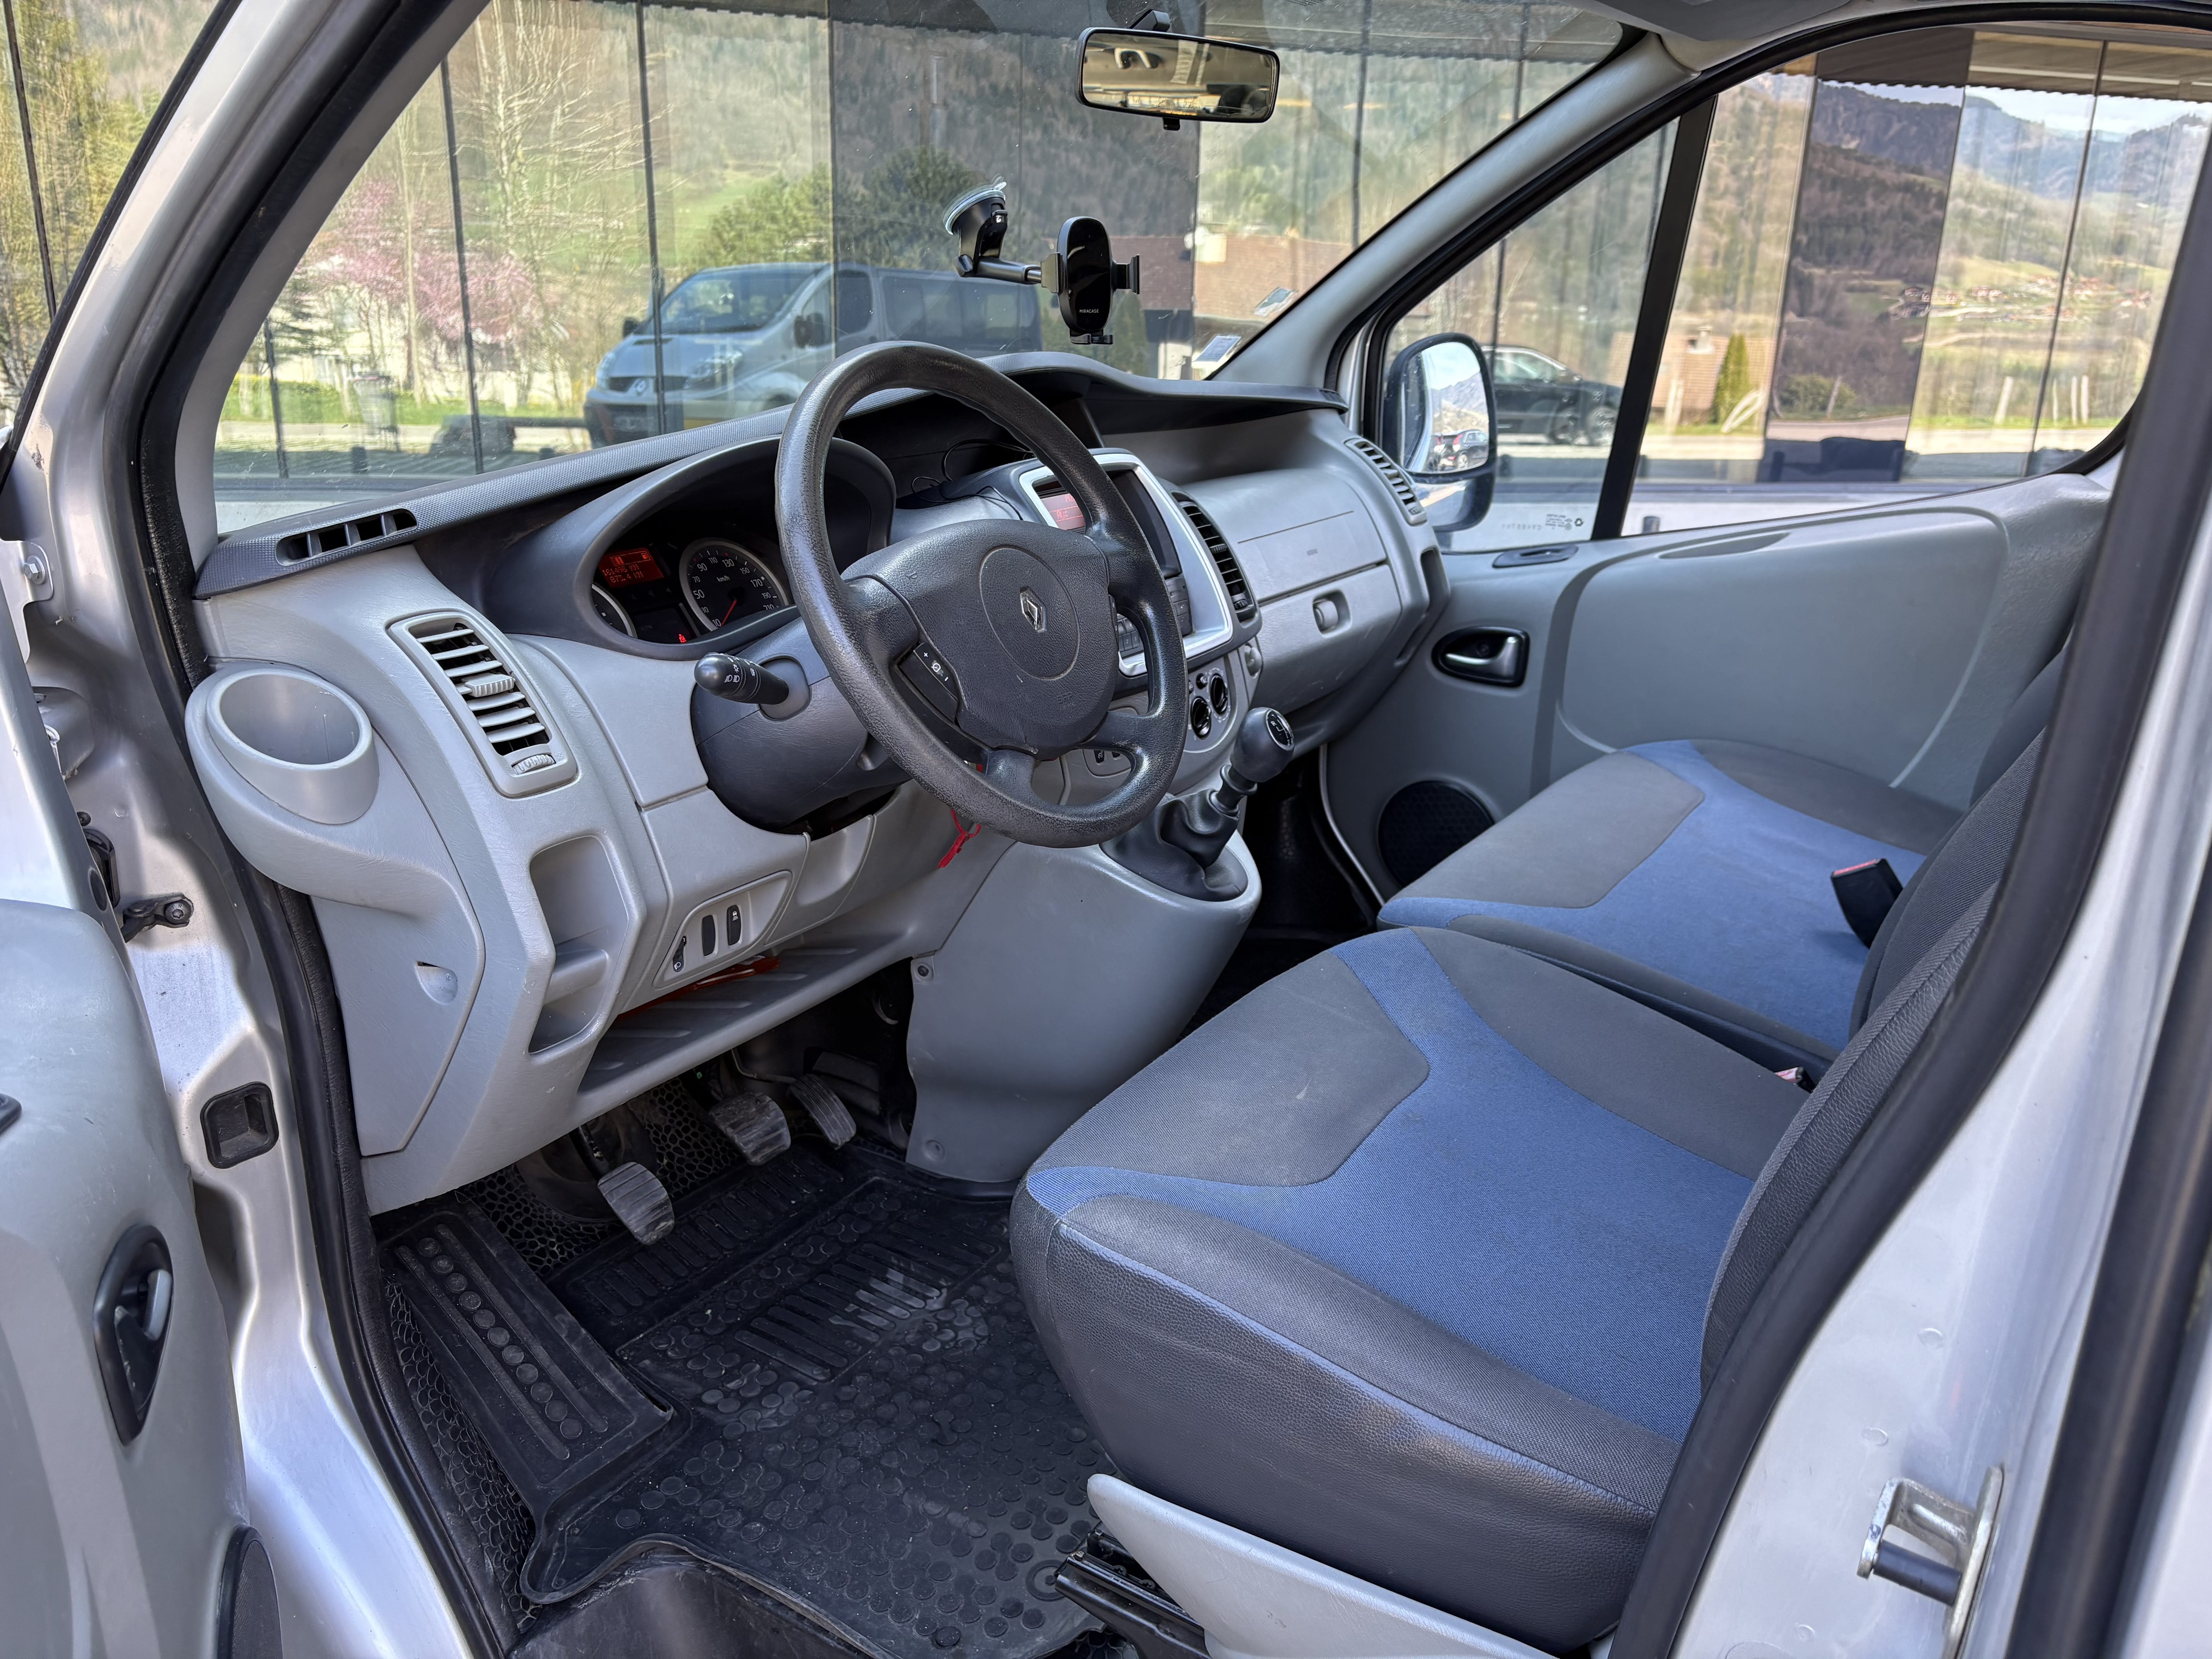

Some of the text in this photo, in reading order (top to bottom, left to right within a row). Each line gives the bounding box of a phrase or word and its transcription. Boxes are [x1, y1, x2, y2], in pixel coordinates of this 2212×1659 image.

[722, 558, 735, 567] 130
[697, 563, 708, 572] 90
[750, 579, 763, 588] 170
[693, 589, 705, 599] 50
[712, 618, 721, 627] 10
